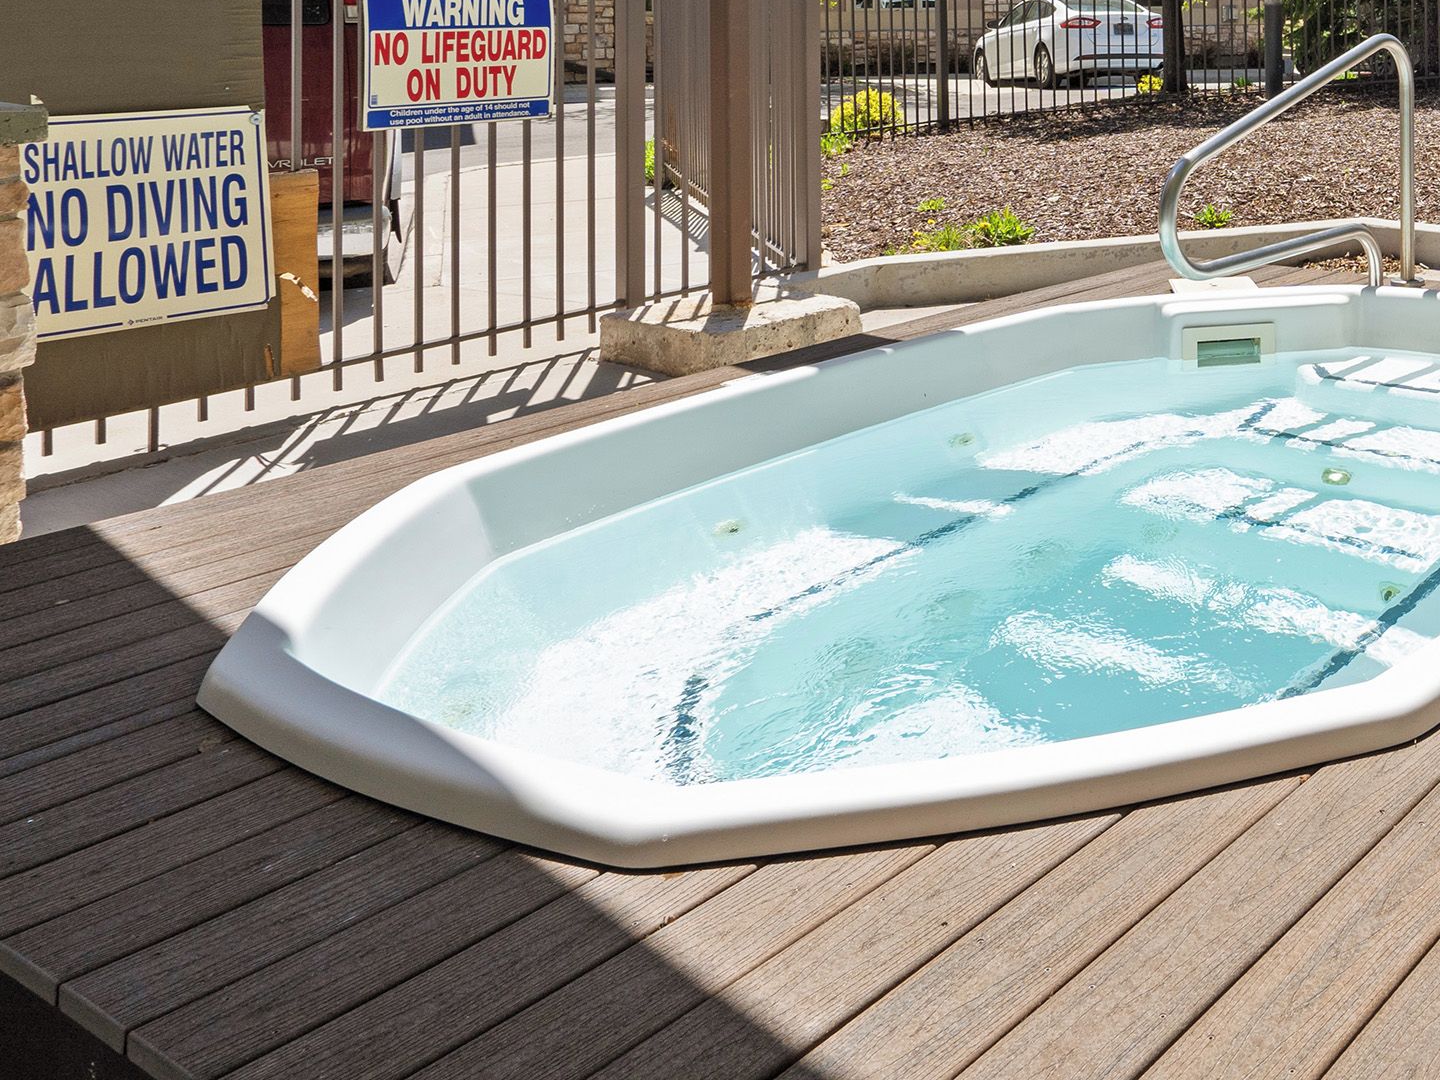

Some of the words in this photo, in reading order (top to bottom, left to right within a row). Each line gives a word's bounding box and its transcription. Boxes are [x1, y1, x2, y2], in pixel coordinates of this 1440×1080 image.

[374, 32, 408, 66] NO
[421, 29, 547, 64] LIFEGUARD
[407, 68, 440, 102] ON
[456, 65, 517, 99] DUTY
[389, 110, 423, 118] Children
[461, 106, 474, 114] age
[494, 102, 517, 110] should
[405, 117, 423, 126] pool
[424, 114, 452, 123] without
[464, 112, 482, 120] adult
[492, 110, 531, 118] attendance.
[24, 135, 153, 184] SHALLOW
[162, 129, 246, 172] WATER
[27, 188, 88, 251] NO
[106, 173, 248, 242] DIVING
[33, 235, 248, 316] ALLOWED
